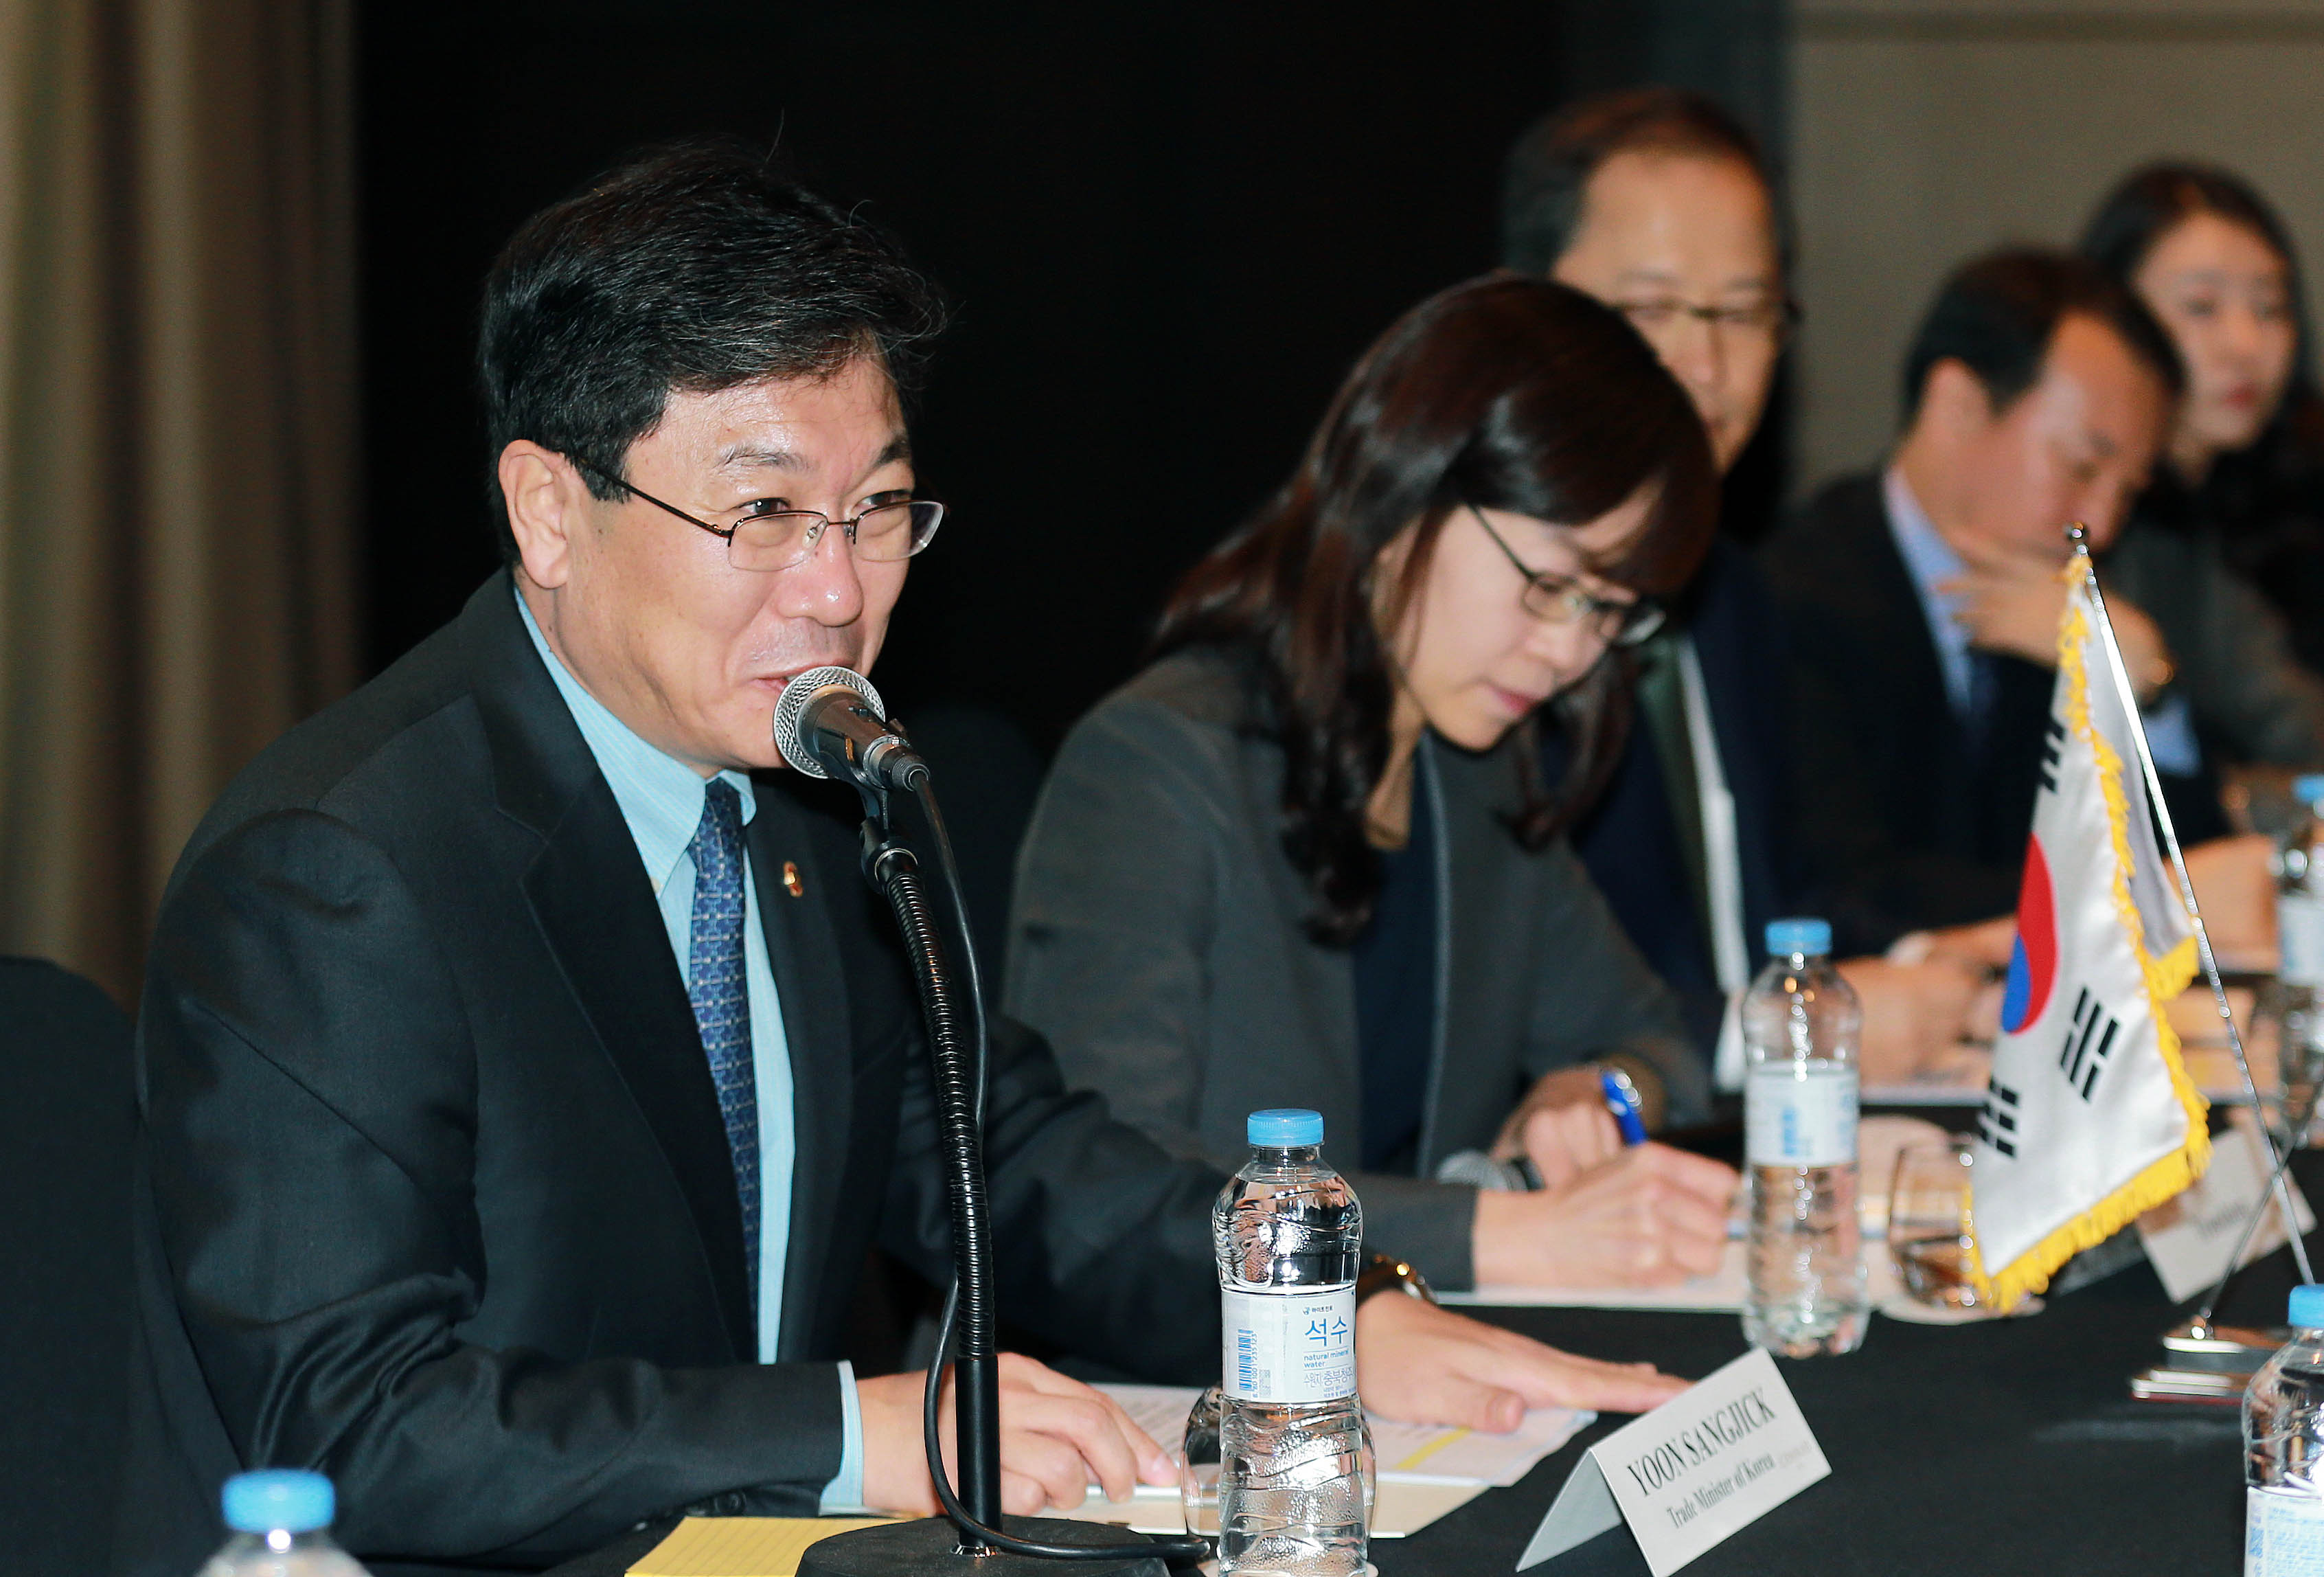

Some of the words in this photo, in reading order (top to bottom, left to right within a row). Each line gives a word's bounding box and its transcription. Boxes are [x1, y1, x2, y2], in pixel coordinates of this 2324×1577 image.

[1303, 1352, 1329, 1361] natural
[1330, 1348, 1349, 1358] mineral
[1305, 1315, 1347, 1347] 석수
[1627, 1438, 1688, 1496] YOON
[1682, 1387, 1775, 1466] SANGJICK
[1667, 1498, 1698, 1528] Trade
[1693, 1478, 1735, 1509] Minister
[1734, 1464, 1747, 1488] of
[1742, 1453, 1775, 1482] Korea
